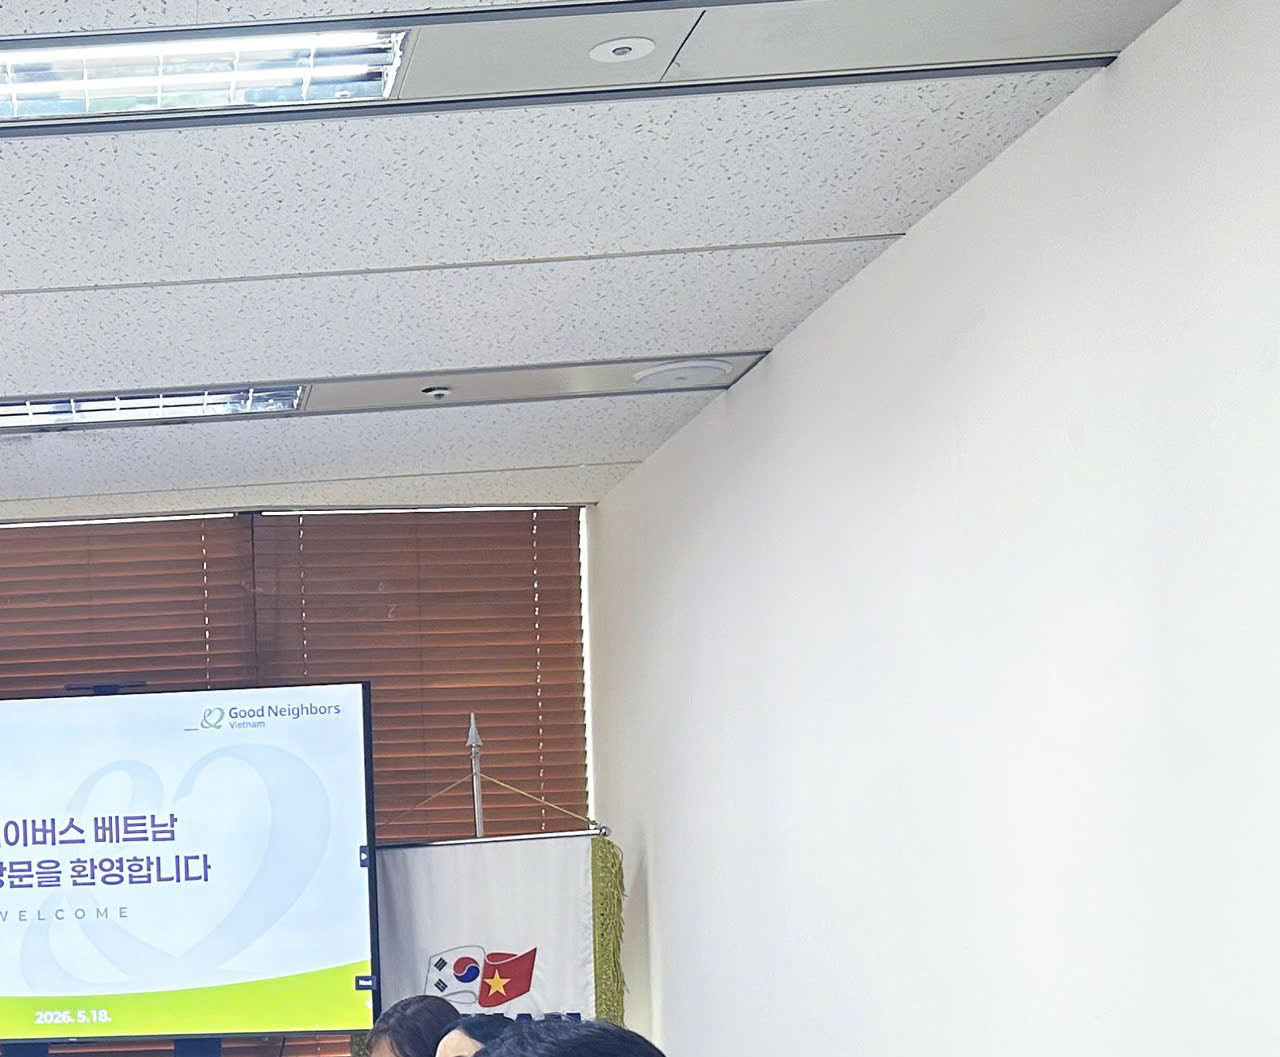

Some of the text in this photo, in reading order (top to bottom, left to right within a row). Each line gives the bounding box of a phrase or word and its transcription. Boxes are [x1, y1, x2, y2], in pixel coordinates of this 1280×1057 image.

[229, 703, 341, 720] Good Neighbors
[229, 720, 266, 729] Vietnam
[93, 813, 178, 844] 베트남
[69, 854, 212, 887] 환영합니다
[34, 1009, 113, 1024] 2026. 5.18.
